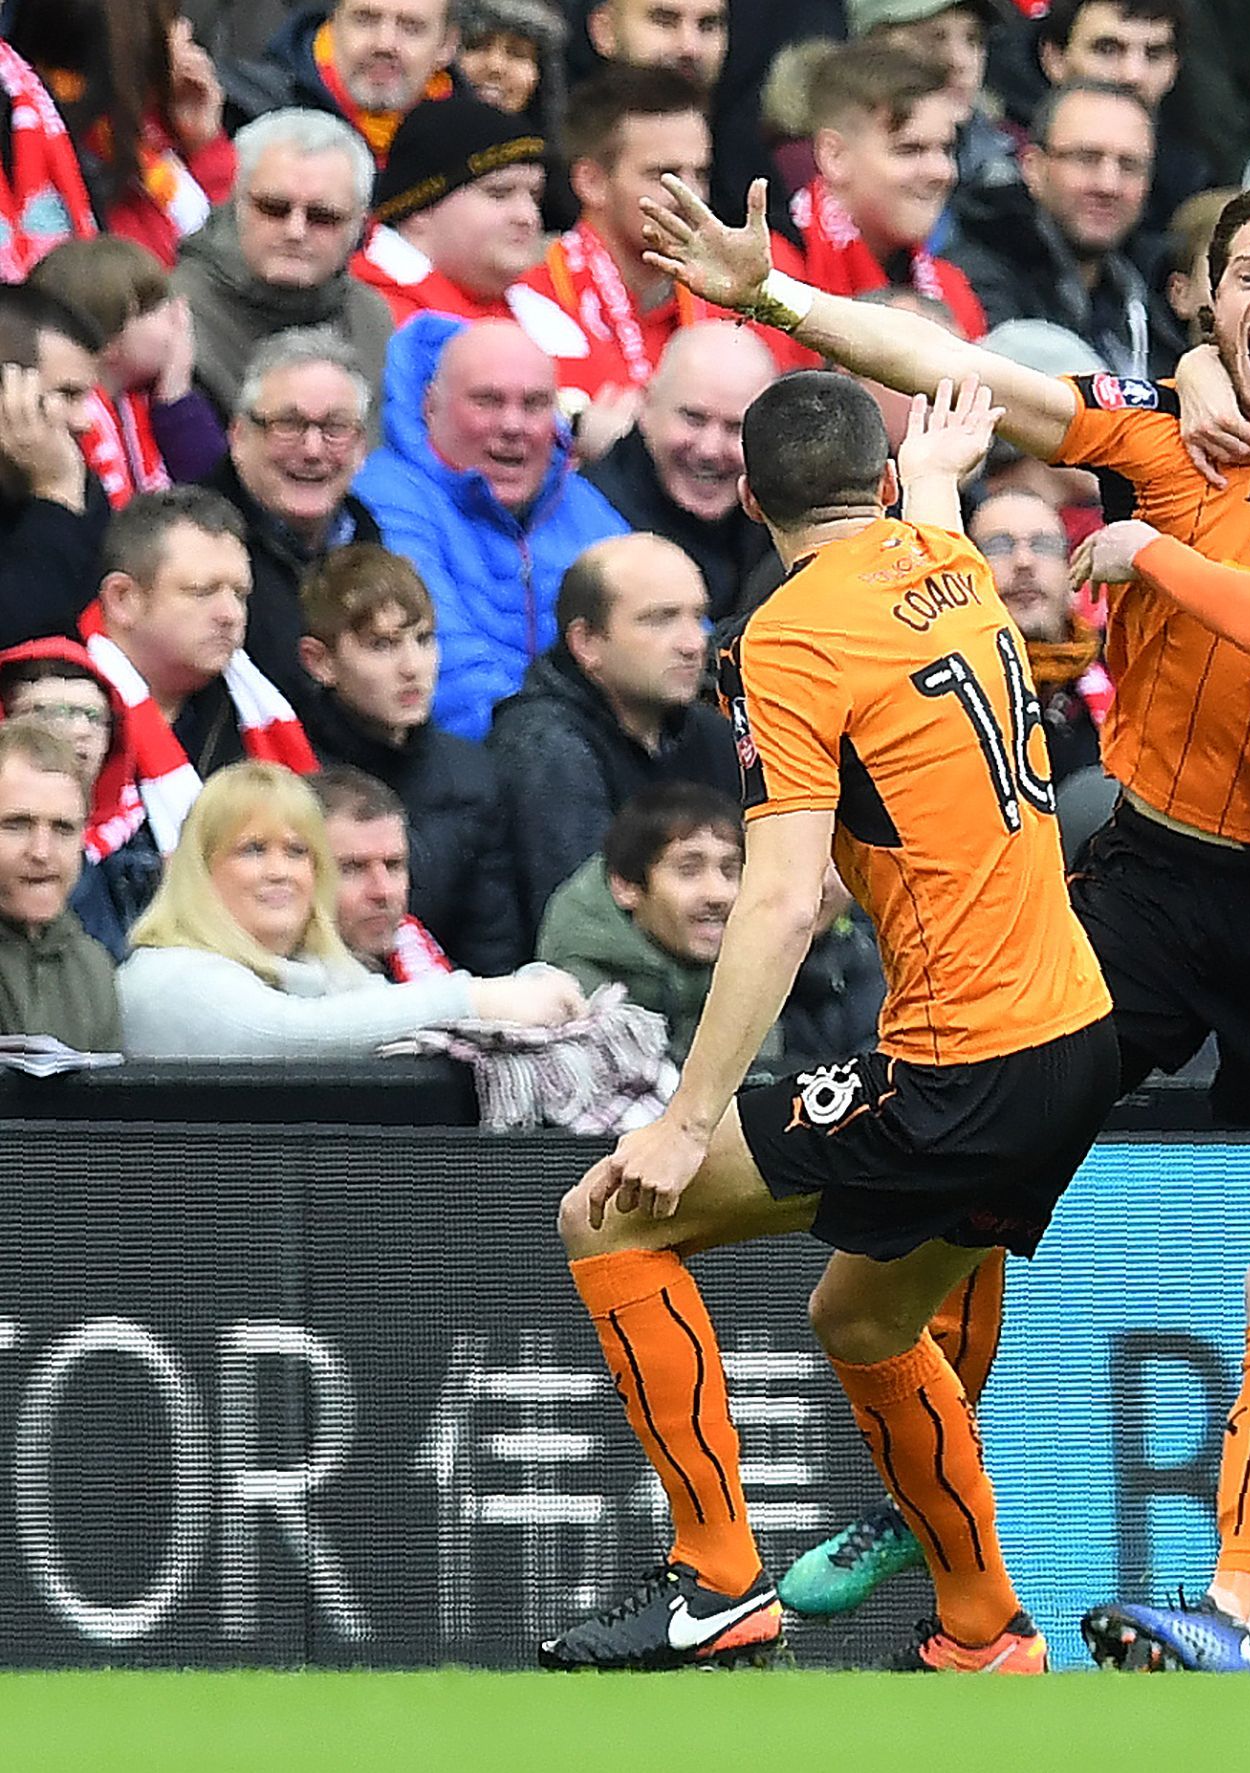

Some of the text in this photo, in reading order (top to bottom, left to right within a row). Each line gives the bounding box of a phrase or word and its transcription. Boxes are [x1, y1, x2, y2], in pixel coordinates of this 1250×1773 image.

[892, 572, 982, 632] COADY
[909, 626, 1057, 834] 16
[0, 1314, 375, 1644] OR
